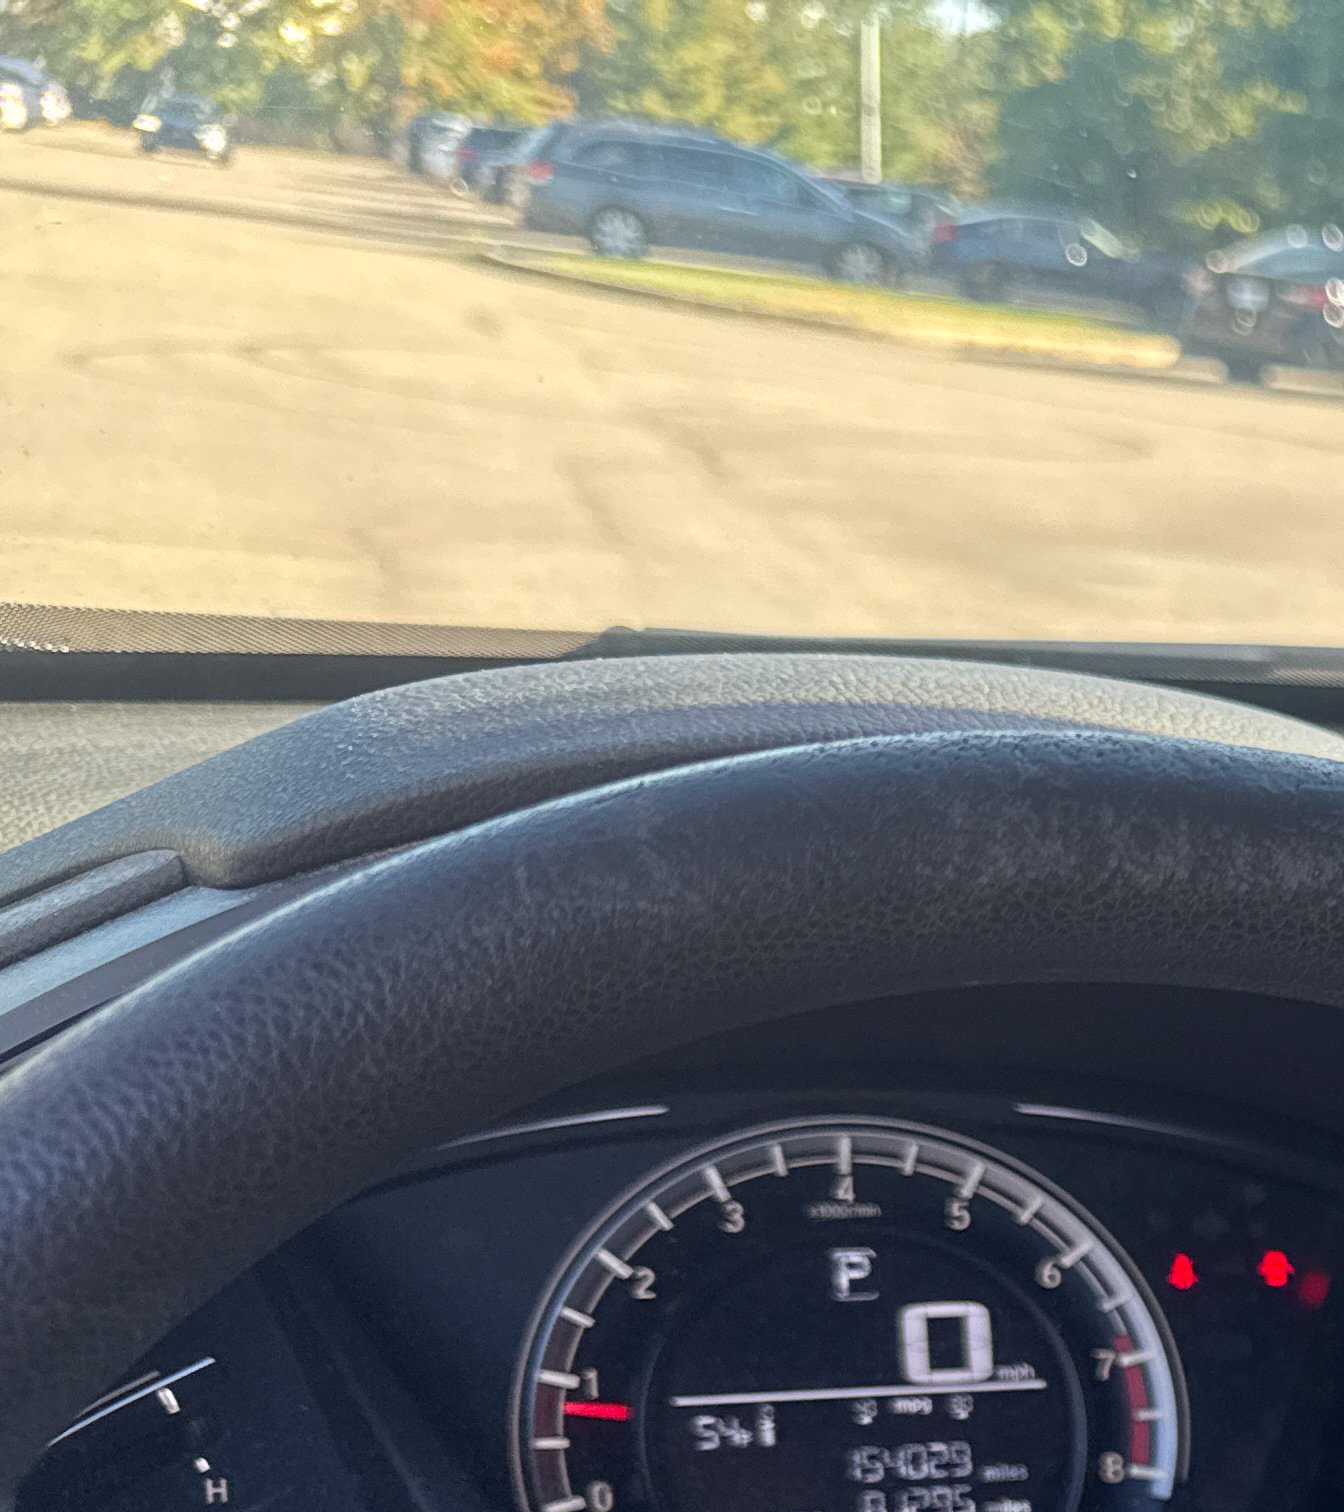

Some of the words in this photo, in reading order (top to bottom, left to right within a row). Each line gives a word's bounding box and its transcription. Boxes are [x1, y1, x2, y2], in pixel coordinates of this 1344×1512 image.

[719, 1200, 745, 1233] 3
[945, 1199, 971, 1231] 5
[632, 1265, 656, 1300] 2
[1036, 1257, 1062, 1289] 6
[901, 1301, 993, 1384] 0
[1092, 1349, 1116, 1381] 7
[582, 1367, 599, 1399] 1
[1099, 1451, 1125, 1484] 8
[206, 1478, 229, 1504] H
